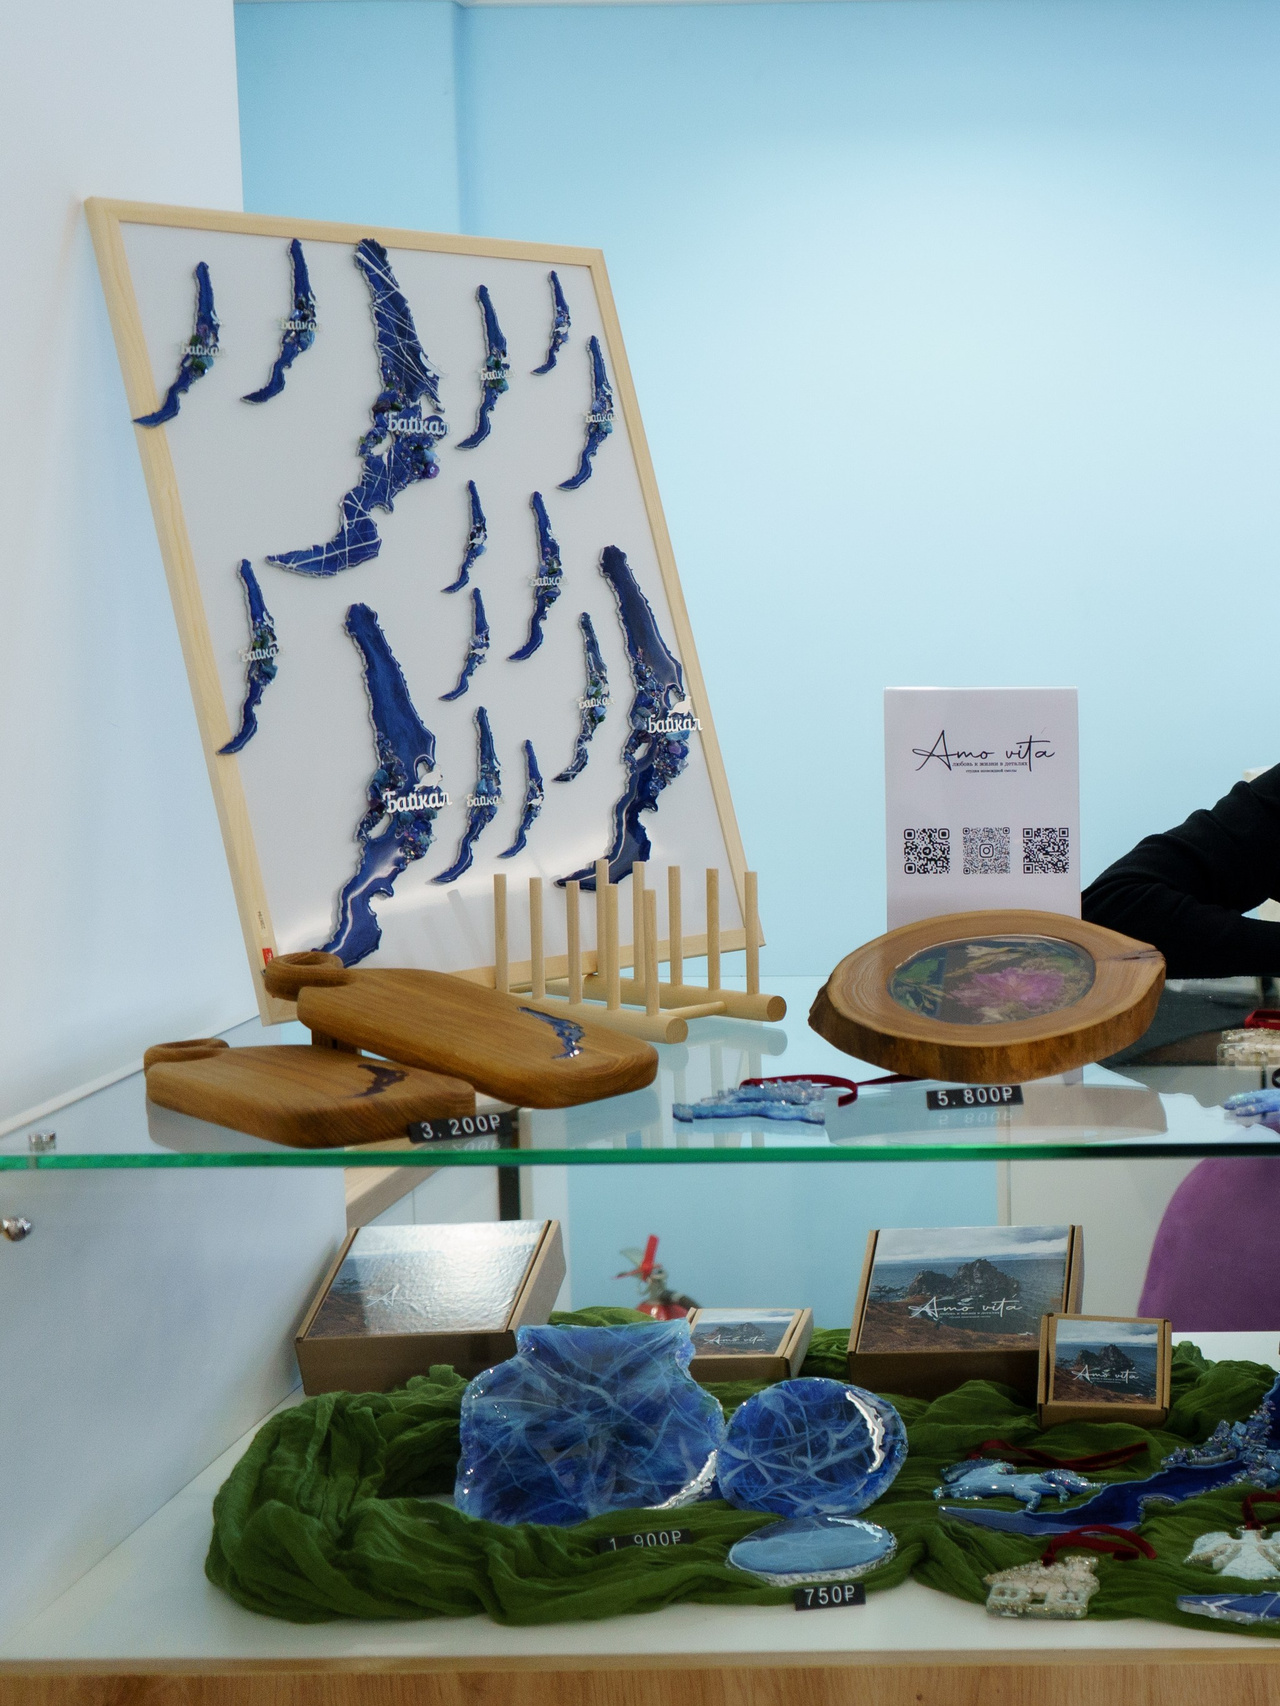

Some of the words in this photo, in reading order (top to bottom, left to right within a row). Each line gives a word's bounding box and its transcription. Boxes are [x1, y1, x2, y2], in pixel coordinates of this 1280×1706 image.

[386, 411, 449, 435] Байкал
[646, 713, 703, 734] Байкал
[912, 729, 995, 771] Amo
[382, 790, 452, 814] Байкал
